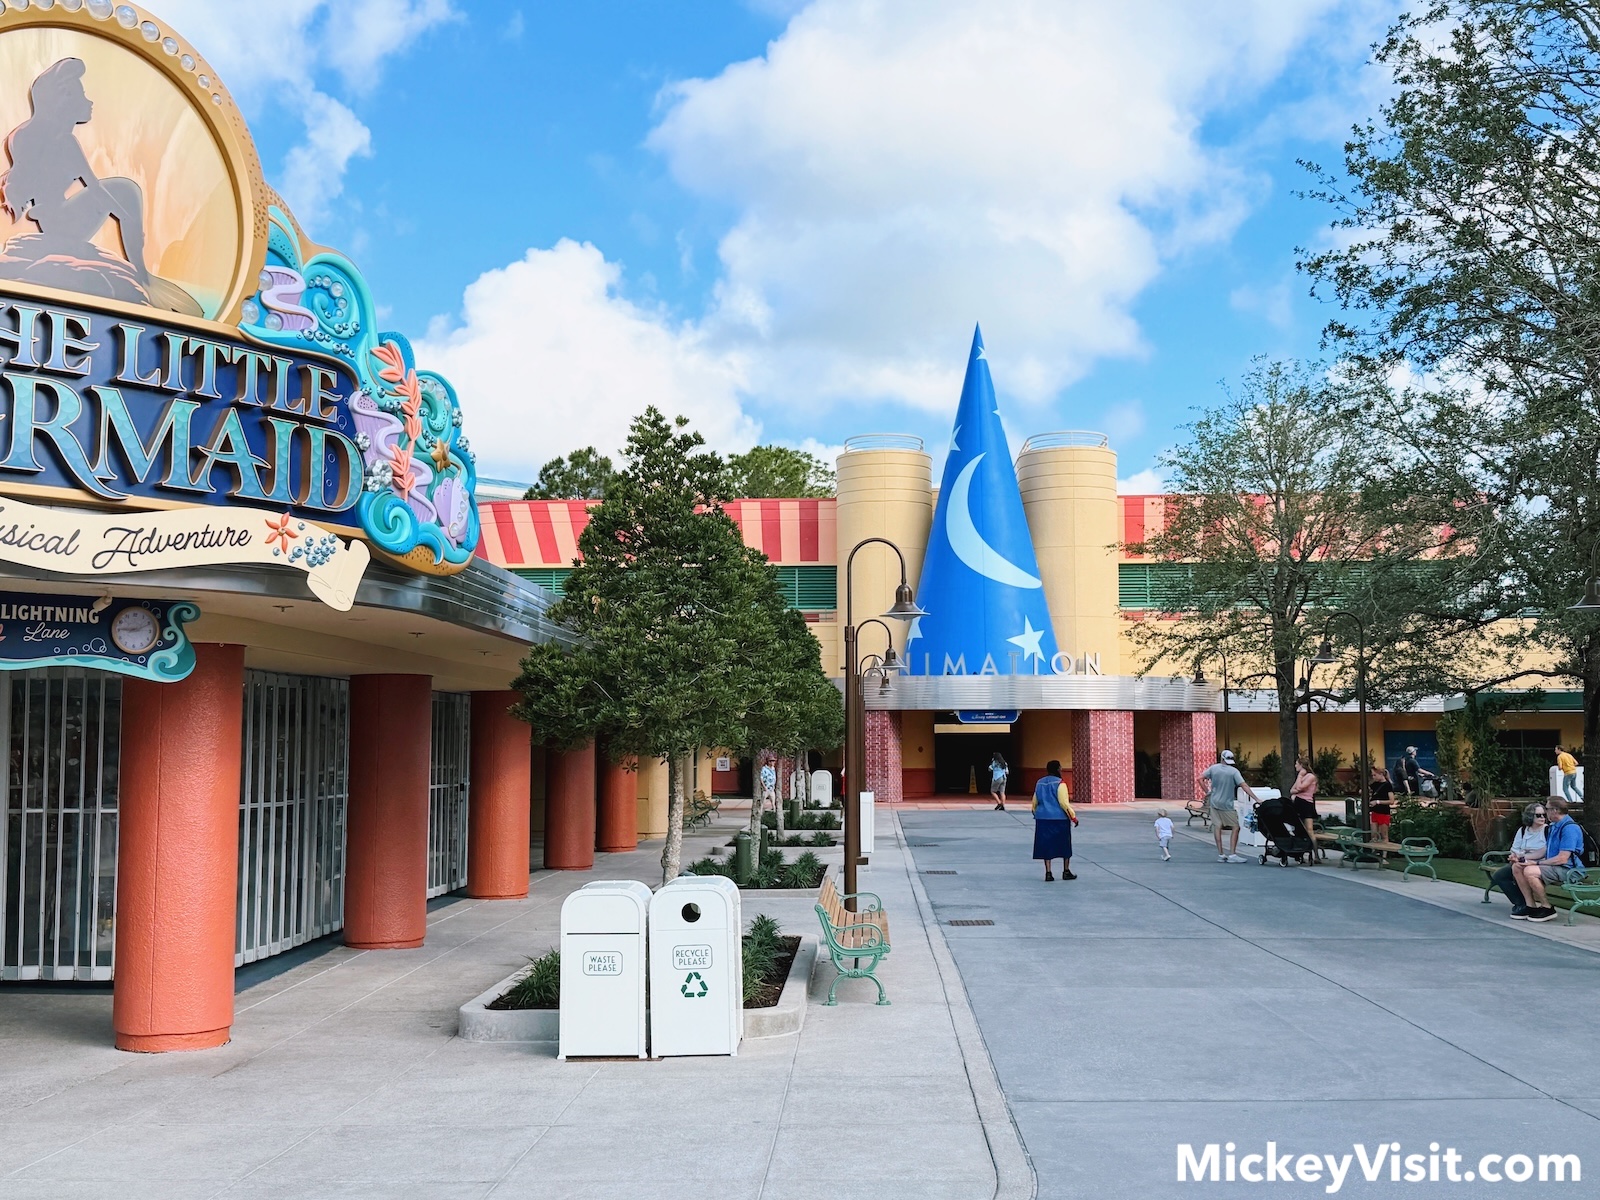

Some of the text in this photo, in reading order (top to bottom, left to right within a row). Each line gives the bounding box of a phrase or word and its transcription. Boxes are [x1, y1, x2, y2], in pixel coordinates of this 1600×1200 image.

[116, 322, 343, 424] LITTLE
[0, 371, 365, 513] RMAID
[0, 521, 253, 570] sical Adventure
[0, 603, 100, 624] LIGHTNING
[23, 621, 71, 642] Lane
[589, 955, 616, 964] WASTE
[675, 949, 709, 958] RECYCLE
[678, 957, 707, 966] PLEASE
[588, 964, 617, 972] PLEASE
